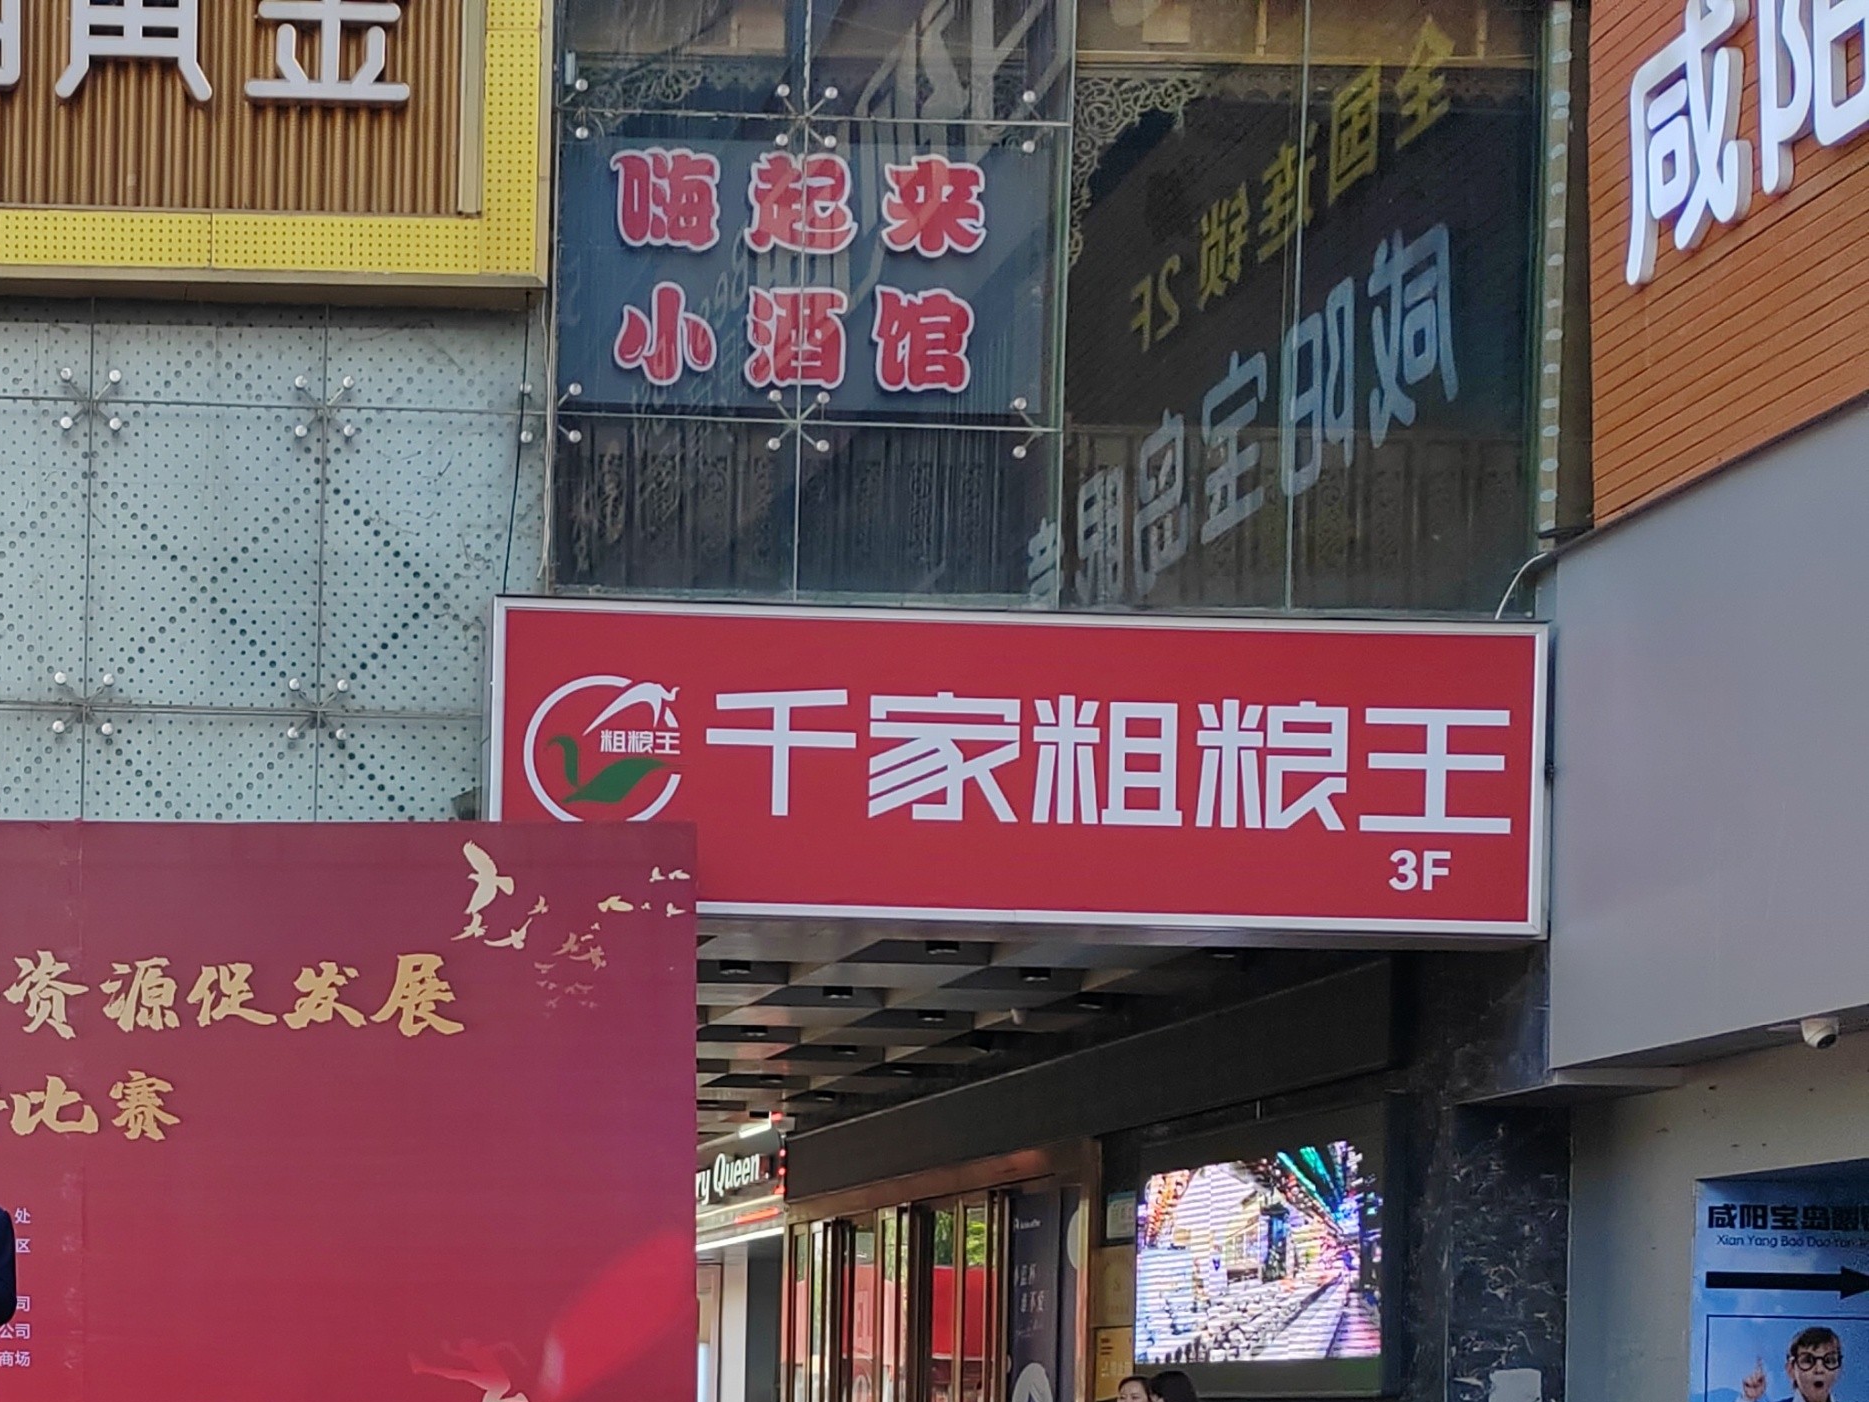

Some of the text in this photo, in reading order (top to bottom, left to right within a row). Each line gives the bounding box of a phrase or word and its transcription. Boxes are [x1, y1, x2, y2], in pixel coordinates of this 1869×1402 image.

[610, 147, 987, 258] 嗨起来
[614, 281, 975, 393] 小酒馆
[600, 729, 681, 755] 粗粮王
[705, 687, 1512, 836] 千家粗粮王
[1388, 850, 1451, 892] 3F
